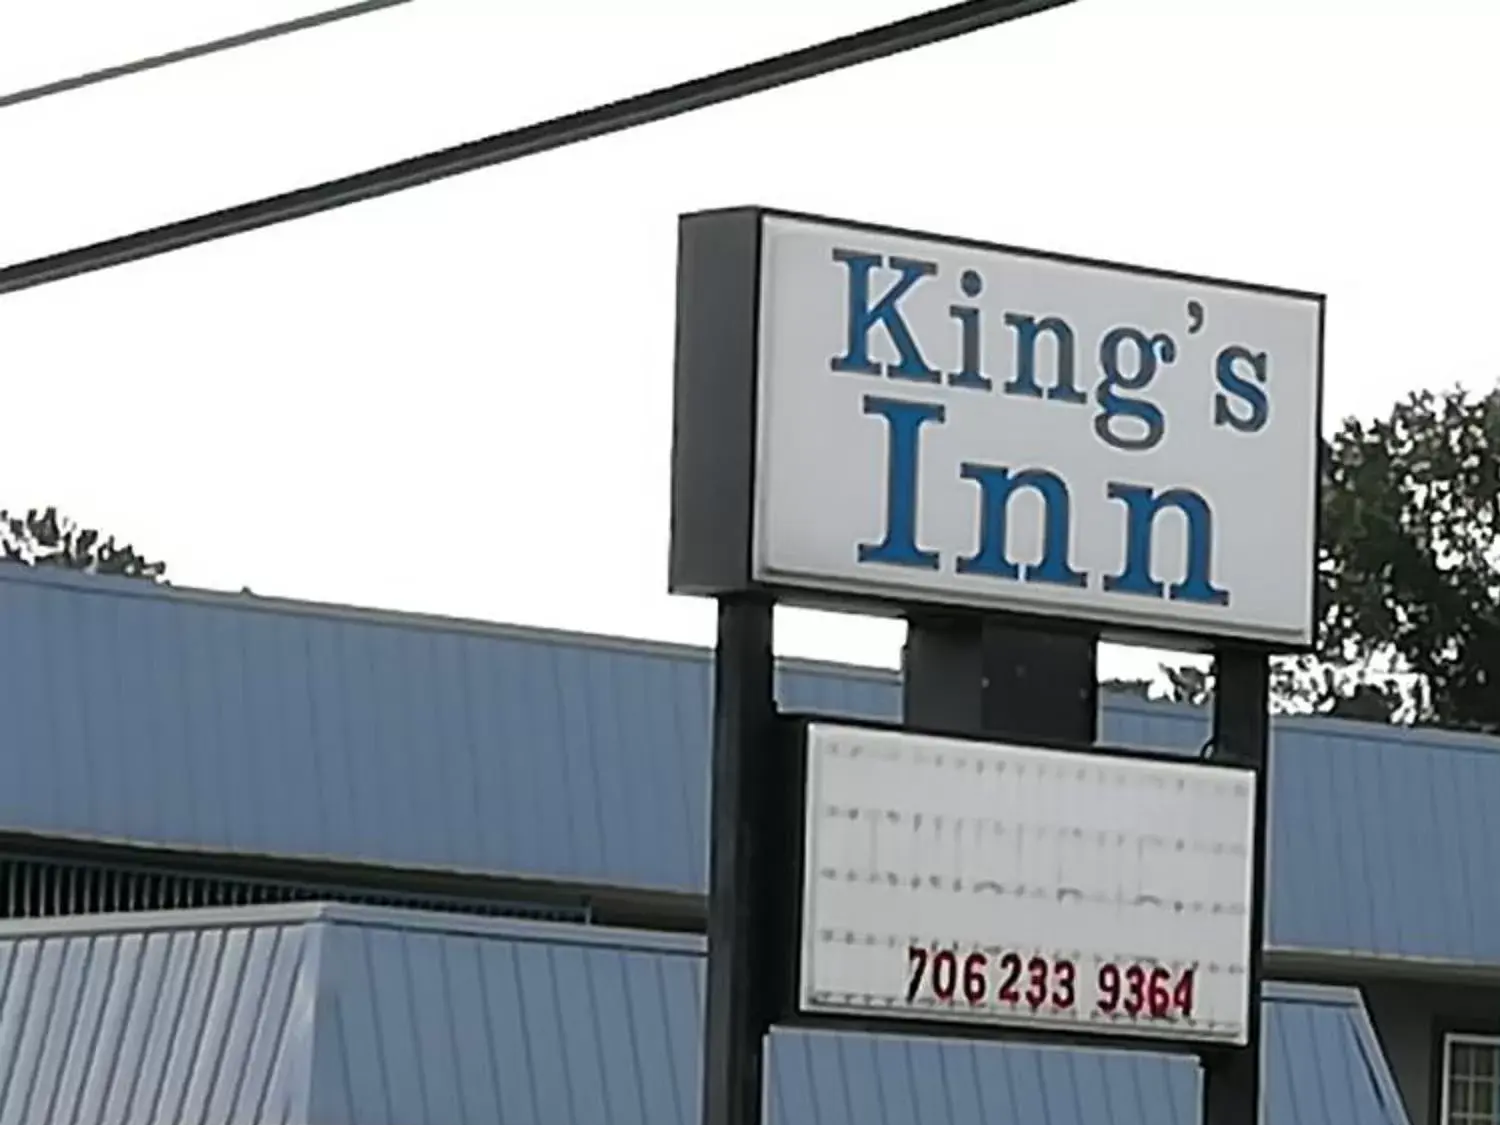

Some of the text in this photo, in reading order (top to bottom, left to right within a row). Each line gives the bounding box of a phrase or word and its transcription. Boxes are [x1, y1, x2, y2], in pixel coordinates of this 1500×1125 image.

[831, 247, 1269, 450] King's
[857, 394, 1229, 607] Inn
[906, 946, 1196, 1018] 706 233 9364
